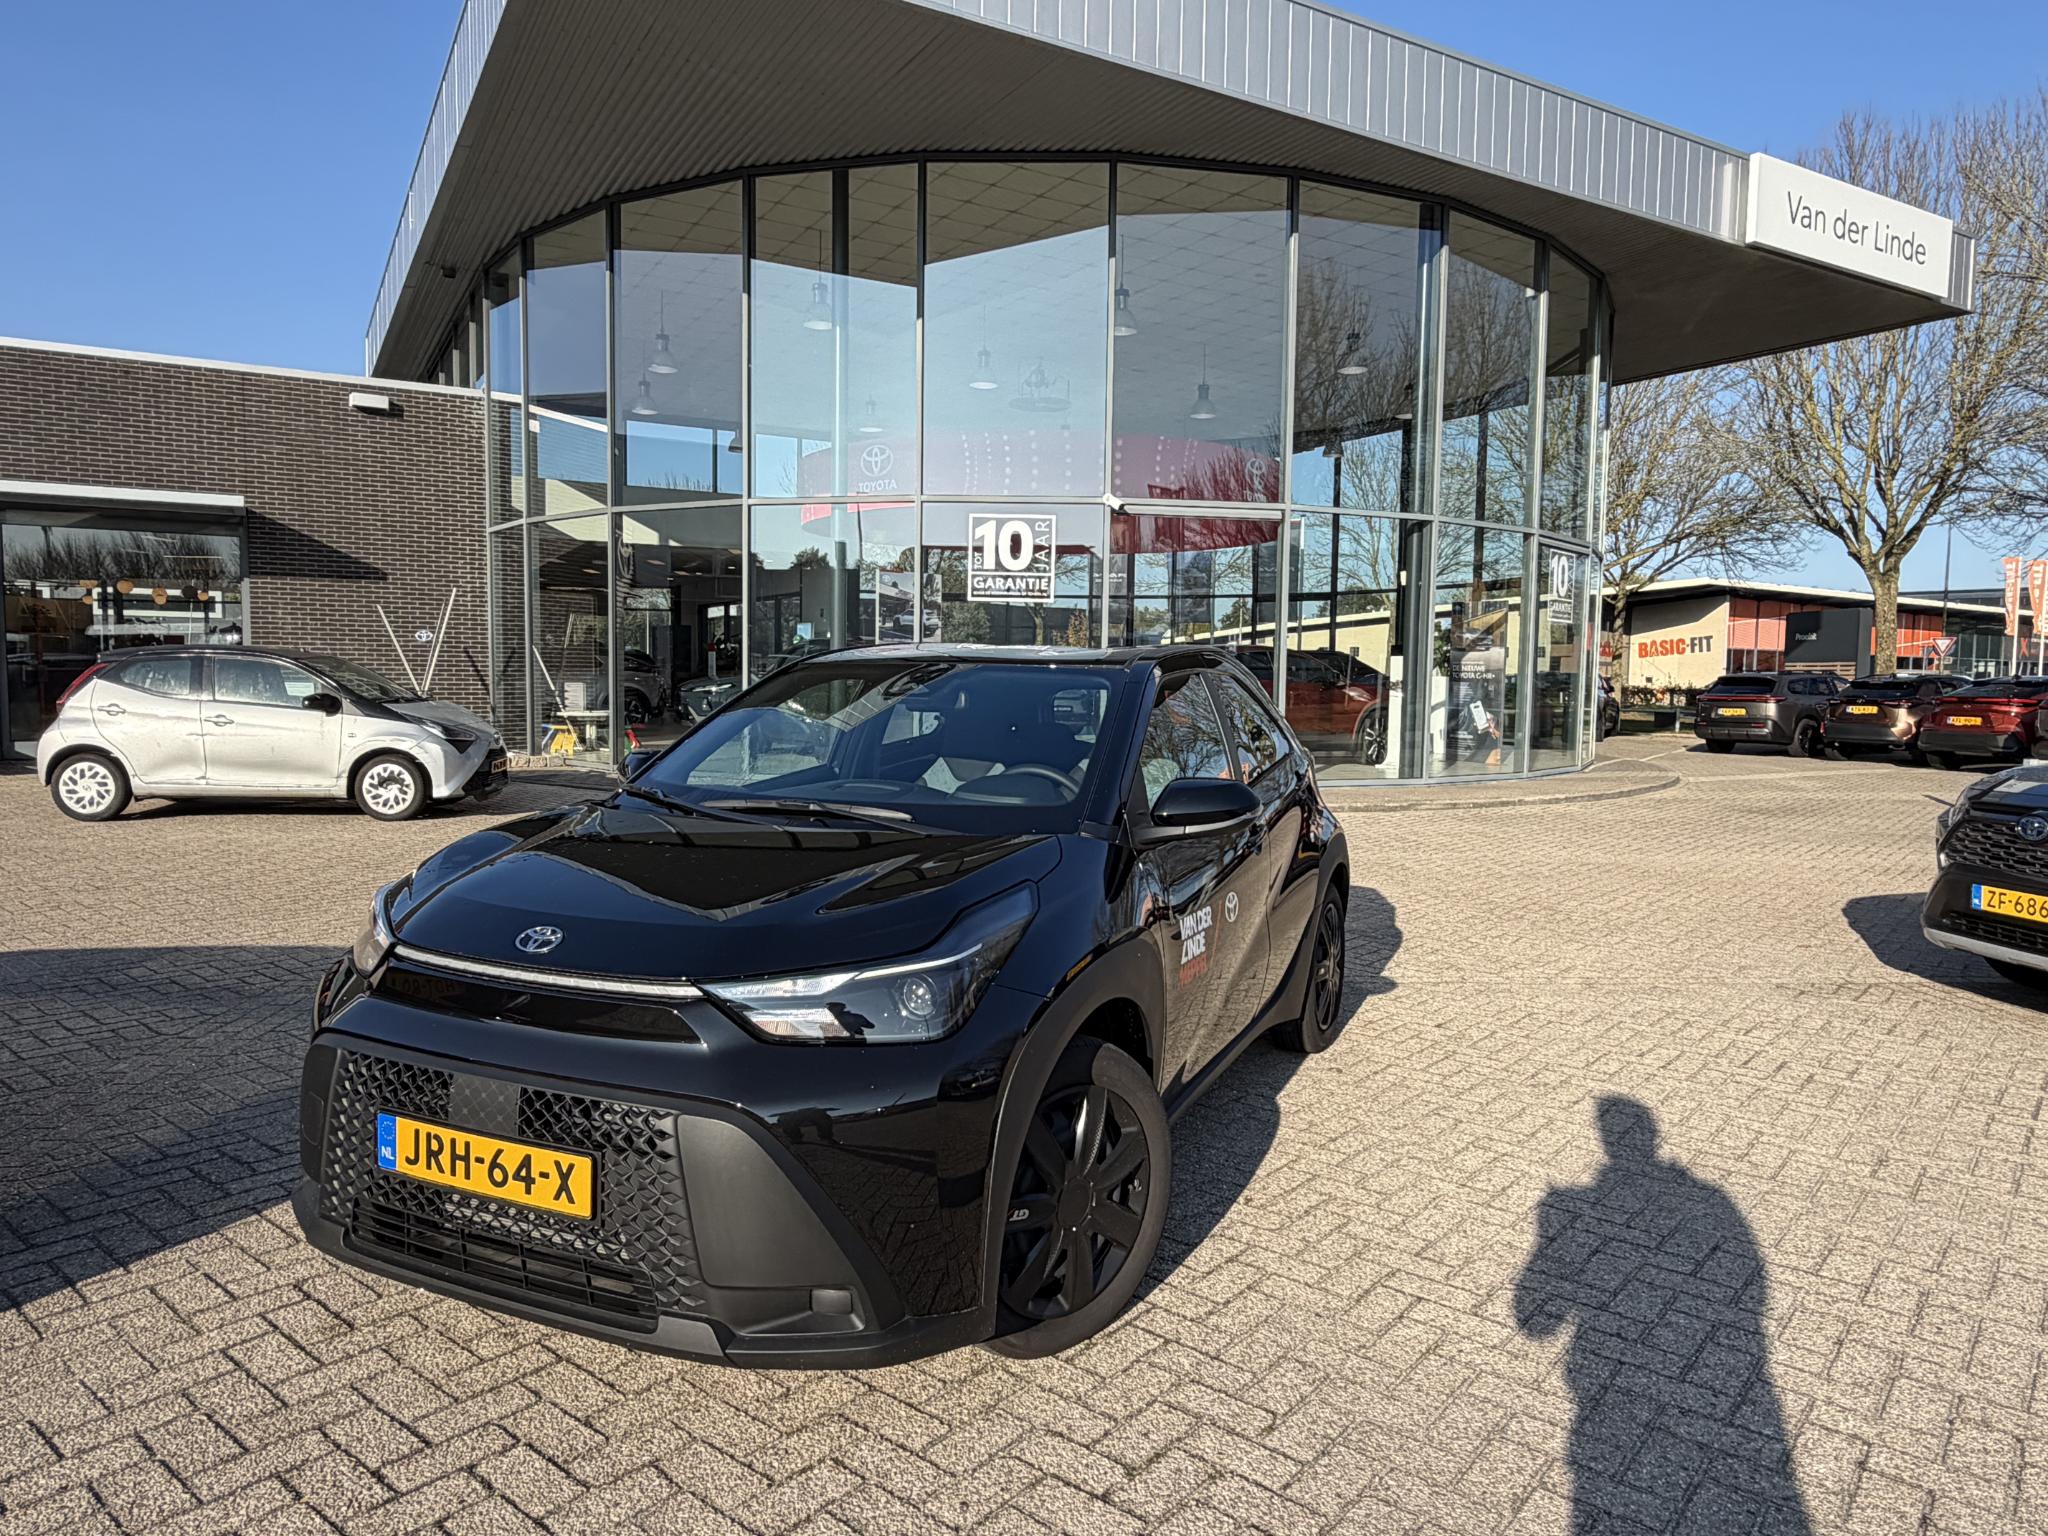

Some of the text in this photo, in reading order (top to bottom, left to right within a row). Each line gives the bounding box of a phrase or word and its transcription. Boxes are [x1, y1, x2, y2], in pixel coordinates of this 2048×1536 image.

[1787, 191, 1926, 265] Van der Linde
[858, 479, 898, 492] TOYOTA
[974, 519, 1034, 571] 10
[1034, 520, 1050, 571] JAAR
[974, 552, 983, 570] TOT
[973, 576, 1049, 590] GARANTIE
[1551, 554, 1569, 598] 10
[1638, 635, 1714, 659] BASIC-FIT
[1986, 890, 2048, 918] ZF-686
[1180, 912, 1198, 940] VAN
[381, 1145, 395, 1160] NL
[404, 1127, 577, 1205] JRH-64-X
